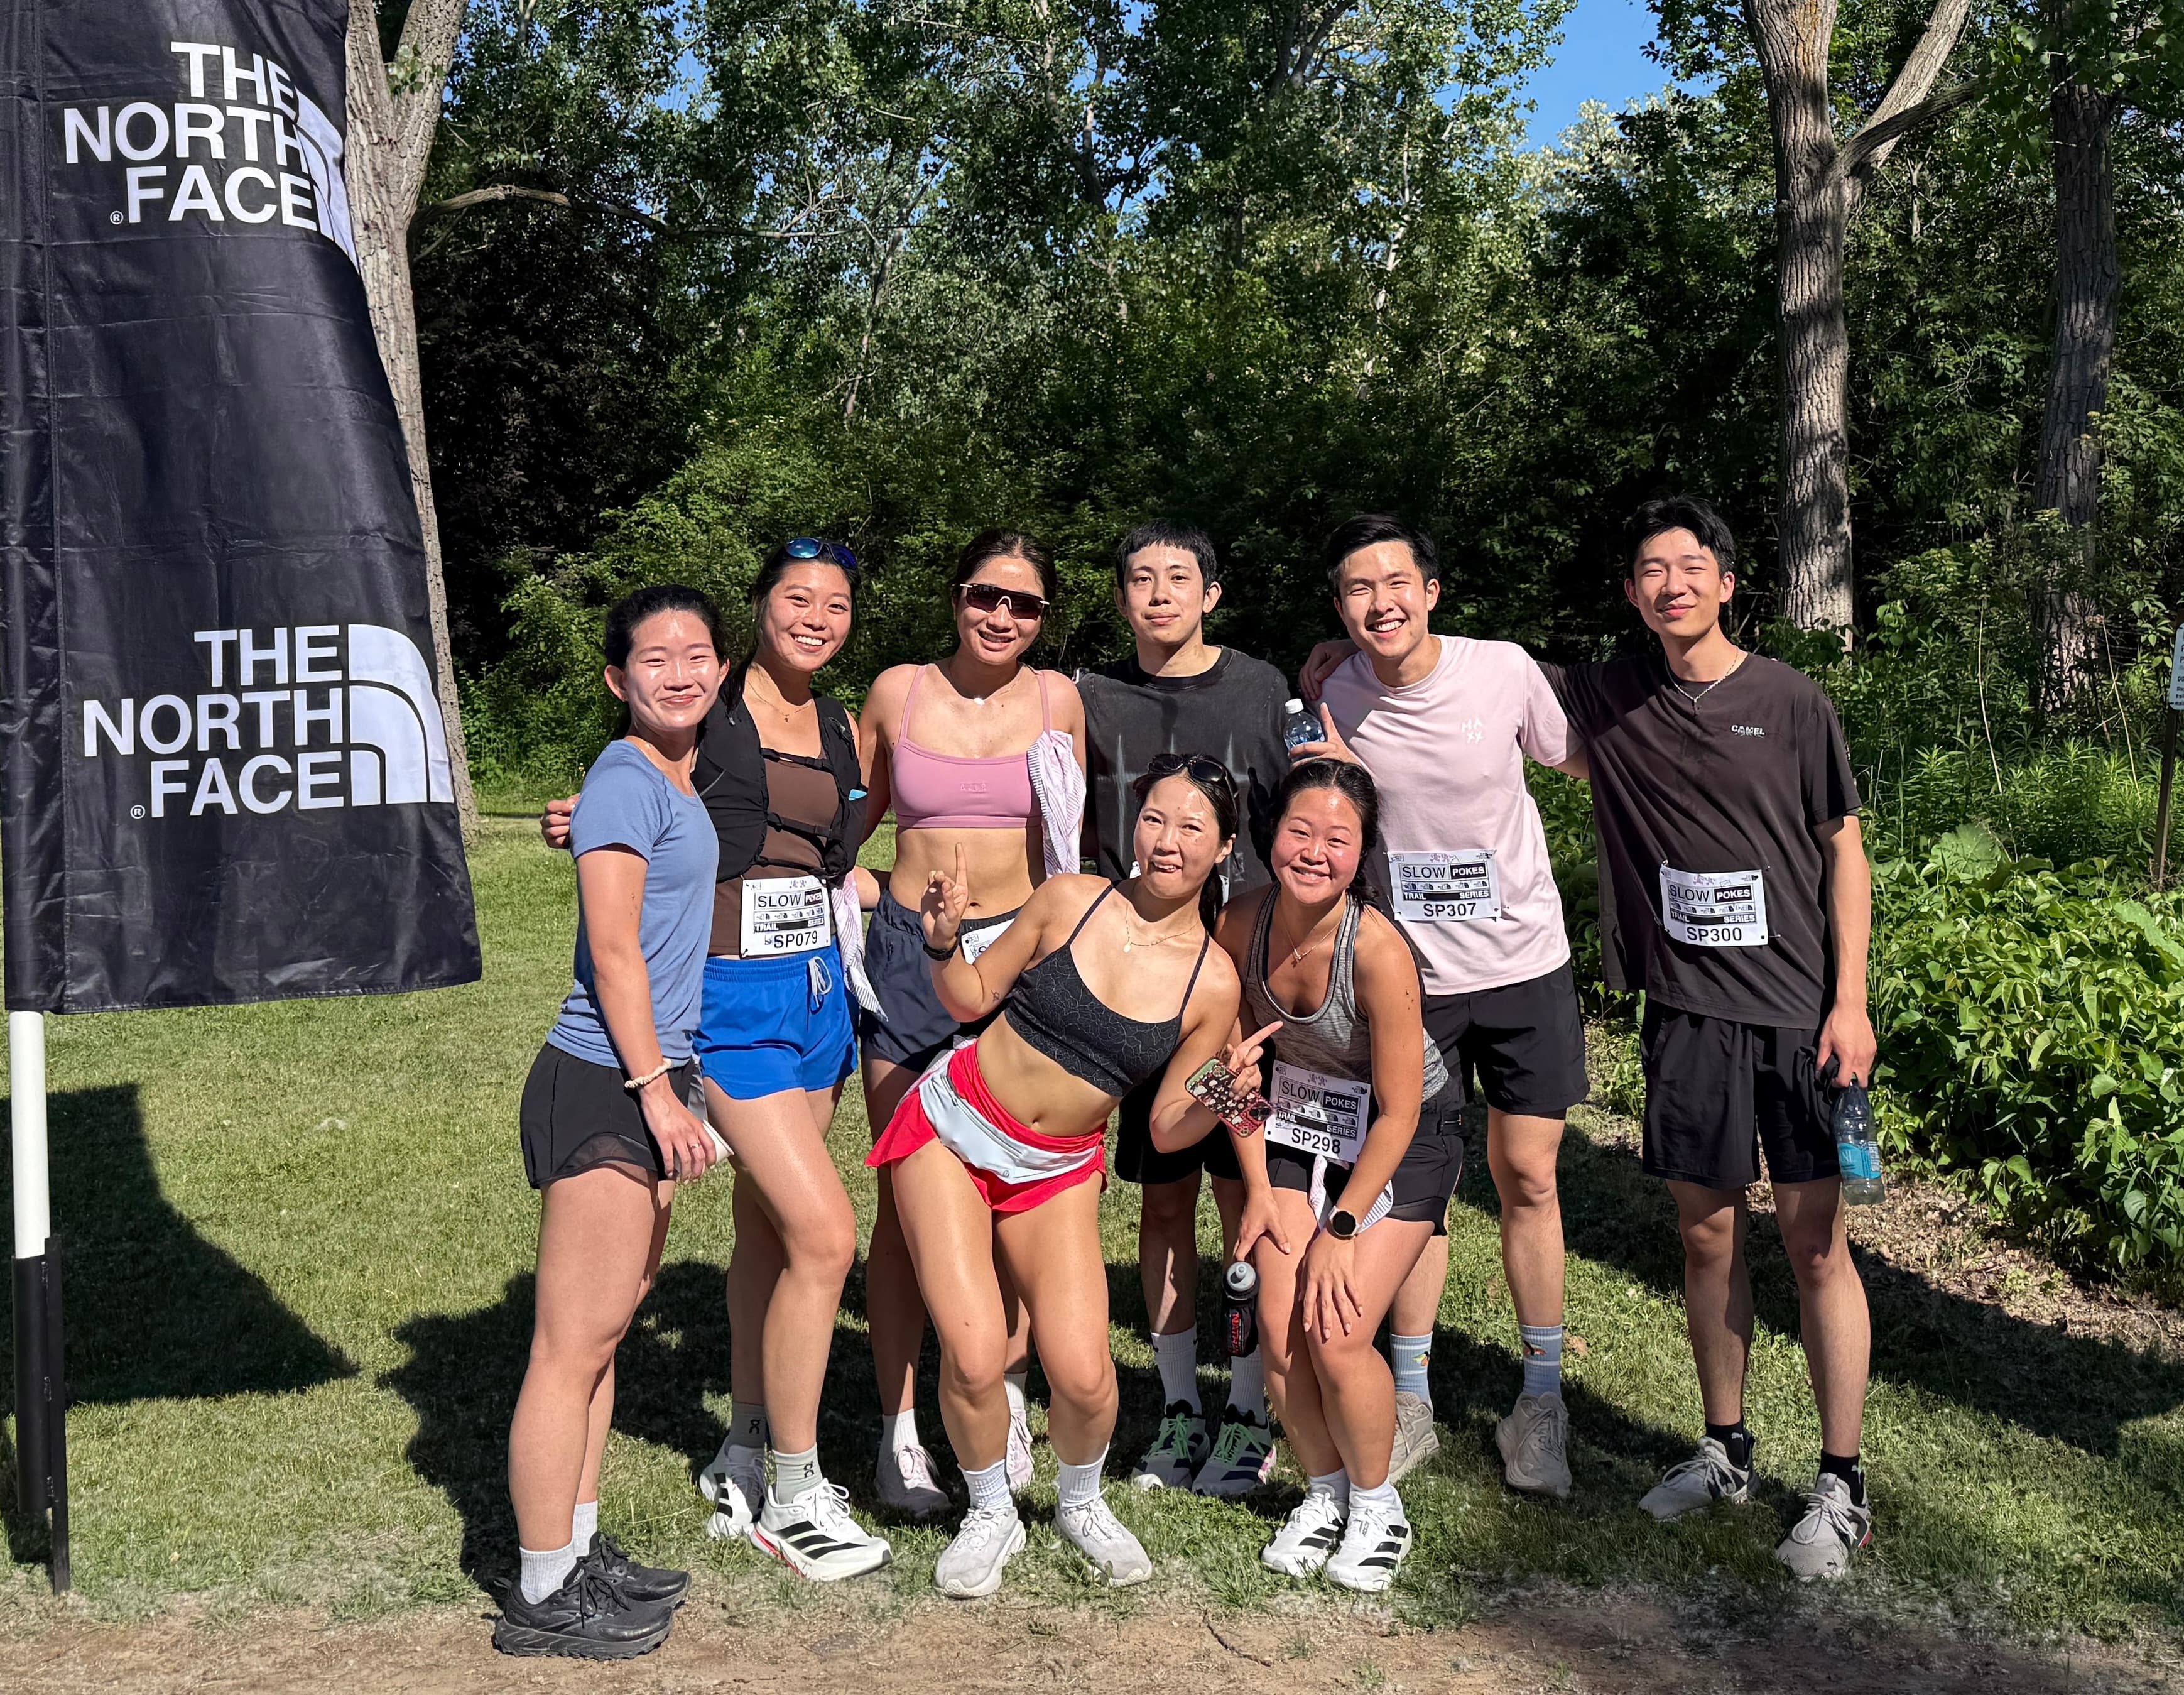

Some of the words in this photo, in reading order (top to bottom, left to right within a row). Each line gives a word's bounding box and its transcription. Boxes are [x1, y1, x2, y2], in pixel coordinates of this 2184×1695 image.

[171, 41, 296, 122] THE
[63, 101, 309, 175] NORTH
[126, 165, 318, 231] FACE
[193, 624, 343, 687] THE
[82, 687, 344, 758] NORTH
[151, 750, 345, 818] FACE
[1402, 866, 1446, 878] SLOW
[1452, 867, 1485, 876] POKES
[758, 893, 801, 908] SLOW
[1459, 890, 1489, 900] SERIES
[1670, 884, 1709, 902] SLOW
[1716, 889, 1751, 900] POKES
[1423, 902, 1477, 917] SP307
[1724, 914, 1755, 924] SERIES
[774, 930, 818, 948] SP079
[1687, 926, 1742, 942] SP300
[1281, 1081, 1320, 1103] SLOW
[1325, 1096, 1357, 1110] POKES
[1277, 1110, 1297, 1123] TRAIL
[1326, 1125, 1357, 1138] SERIES
[1291, 1128, 1341, 1155] SP298
